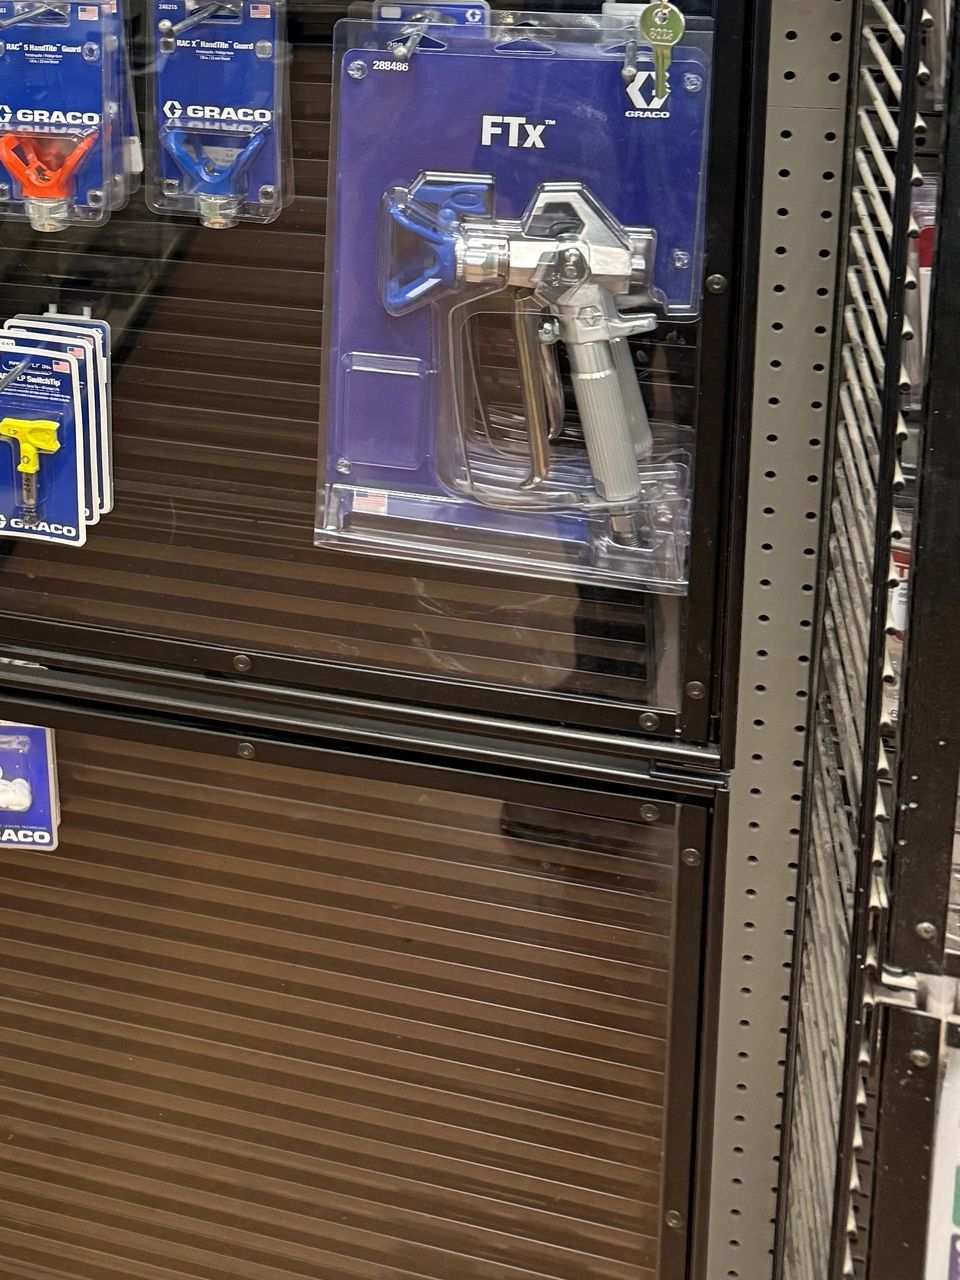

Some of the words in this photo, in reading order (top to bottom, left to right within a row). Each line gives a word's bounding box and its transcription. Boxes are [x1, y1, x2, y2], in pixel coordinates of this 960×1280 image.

[62, 45, 82, 53] Guard
[233, 42, 254, 50] Guard
[372, 60, 409, 72] 288486
[17, 109, 101, 125] GRACO
[187, 106, 272, 121] GRACO
[625, 111, 670, 119] GRACO
[10, 517, 77, 537] GRACO
